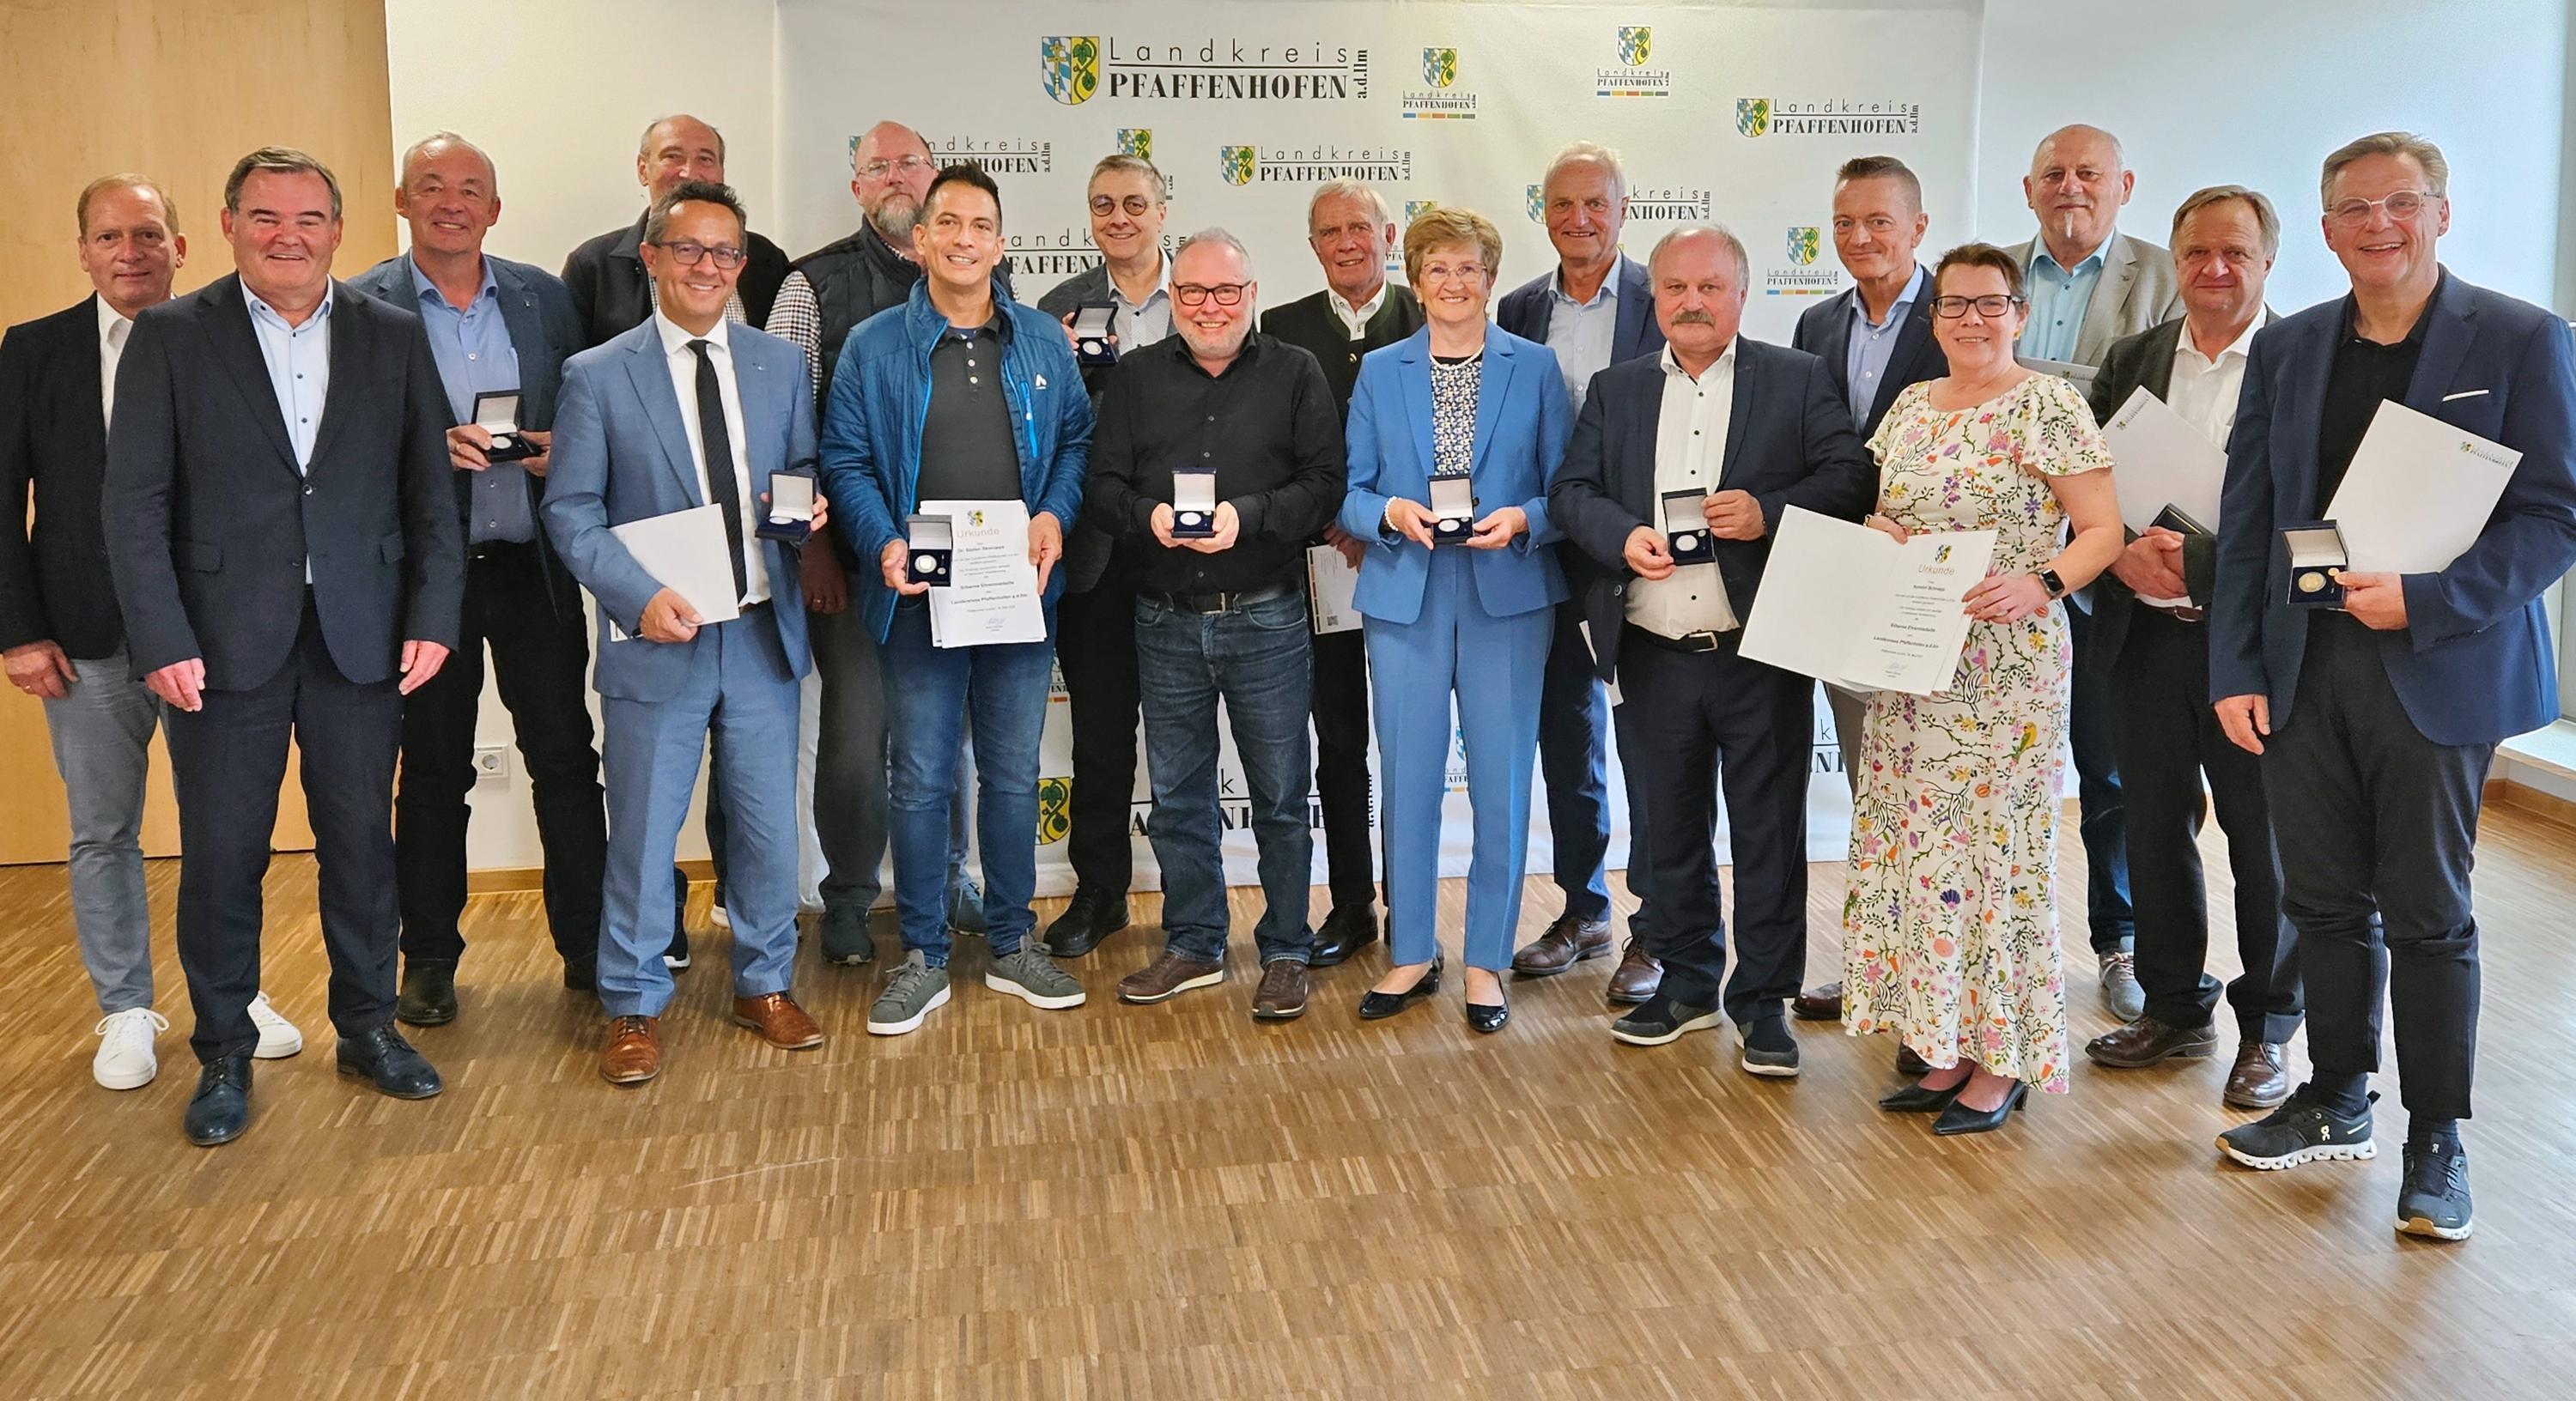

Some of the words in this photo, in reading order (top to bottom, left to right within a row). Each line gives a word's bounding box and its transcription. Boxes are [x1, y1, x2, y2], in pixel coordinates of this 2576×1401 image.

[1109, 37, 1347, 63] Landkreis
[1109, 73, 1347, 99] PFAFFENHOFEN
[1597, 78, 1664, 87] PFAFFENHOFEN
[1402, 100, 1471, 109] PFAFFENHOFEN
[1773, 99, 1907, 113] Landkreis
[1773, 118, 1907, 134] PFAFFENHOFEN
[927, 136, 1038, 151] ndkreis
[1260, 145, 1399, 161] Landkreis
[1260, 166, 1399, 181] PFAFFENHOFEN
[1633, 185, 1698, 199] kreis
[1629, 205, 1698, 220] NHOFEN
[957, 528, 1000, 538] Urkunde
[1918, 564, 1955, 575] Urkunde
